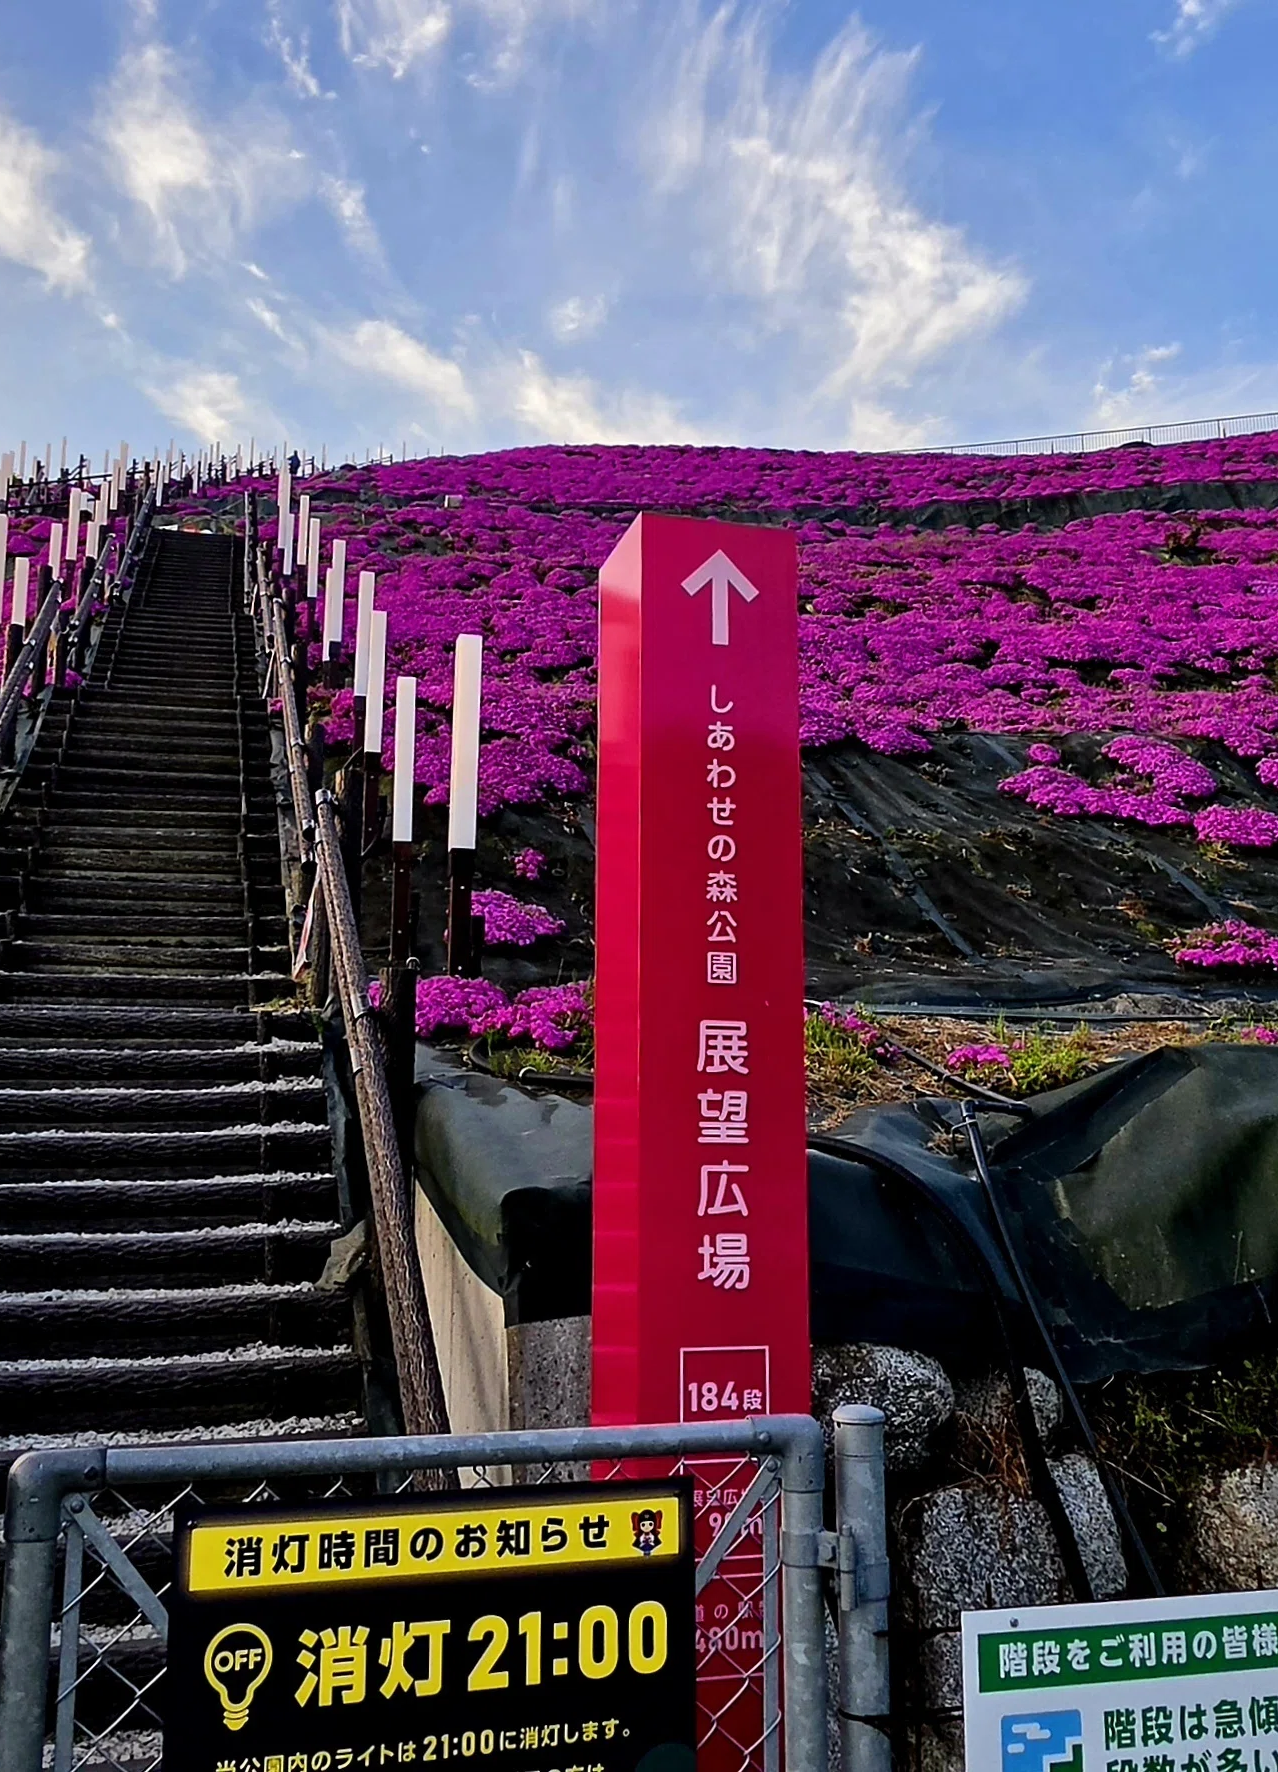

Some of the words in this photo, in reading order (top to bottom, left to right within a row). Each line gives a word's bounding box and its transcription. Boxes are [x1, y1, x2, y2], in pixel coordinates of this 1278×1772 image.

[706, 684, 738, 985] しあわせの森公園
[696, 1019, 750, 1291] 展望広場
[687, 1380, 763, 1411] 184段
[223, 1514, 611, 1580] 消灯時間のお知らせ
[213, 1647, 262, 1672] OFF
